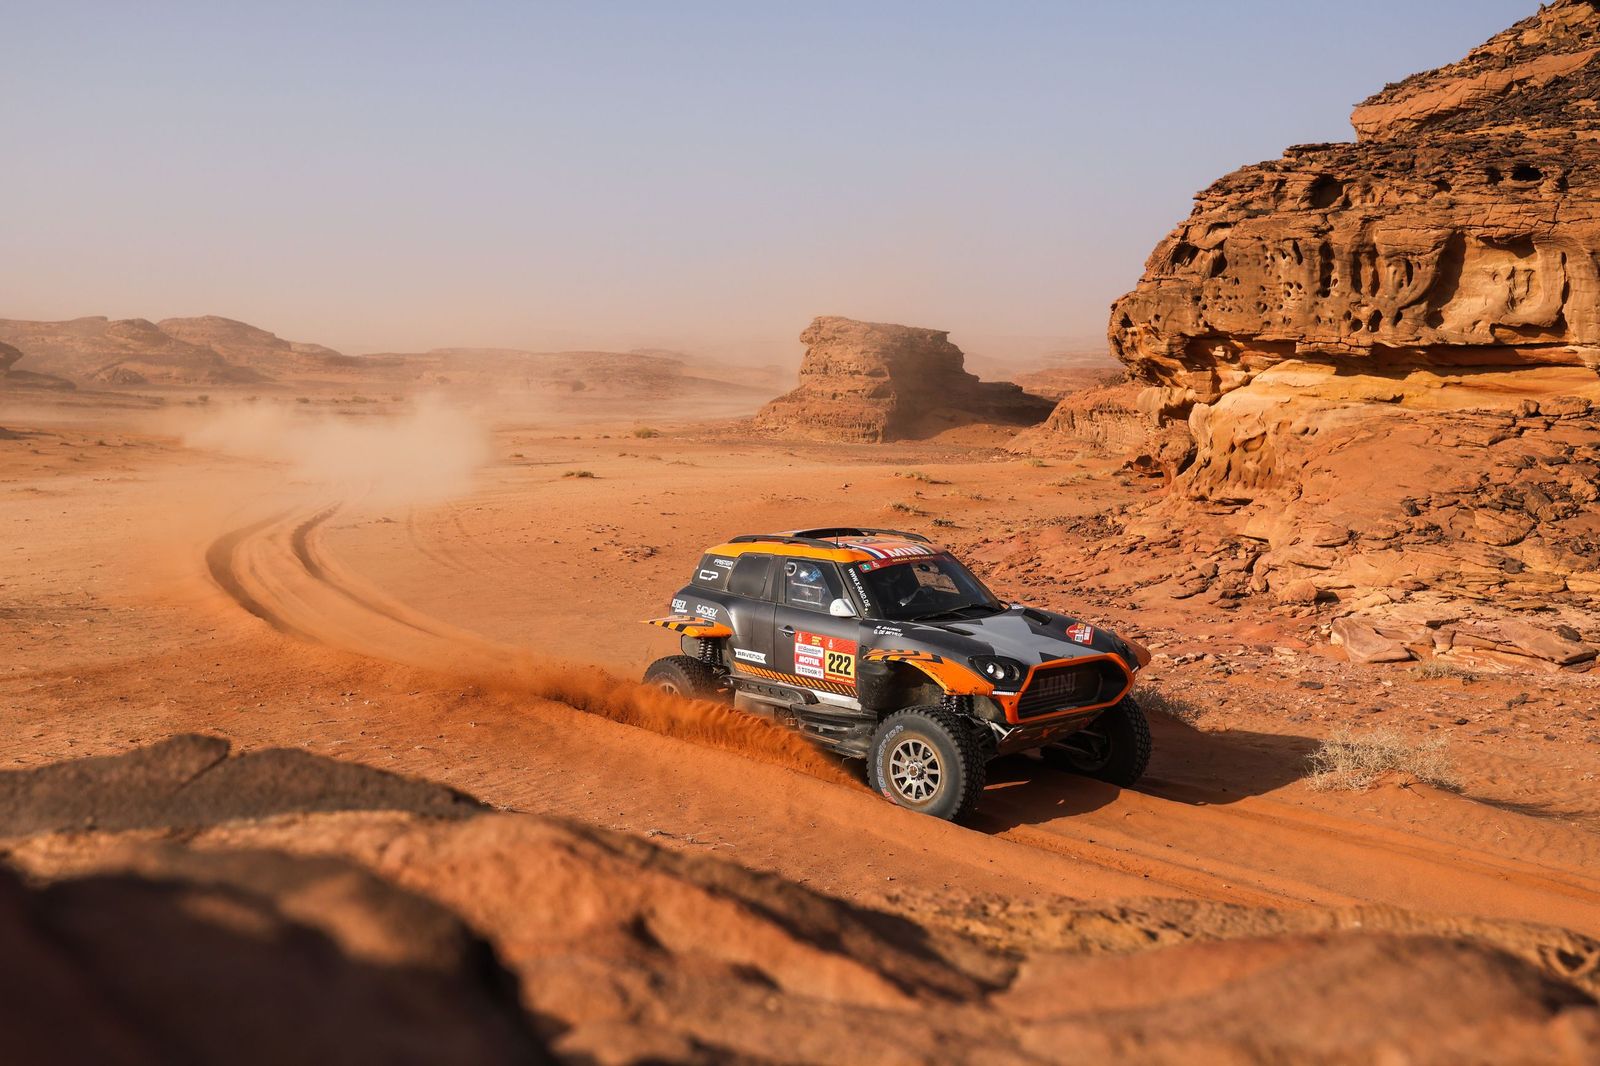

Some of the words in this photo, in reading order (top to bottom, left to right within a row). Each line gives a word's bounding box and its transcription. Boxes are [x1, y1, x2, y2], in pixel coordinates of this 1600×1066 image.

[884, 545, 930, 557] MINI
[700, 569, 719, 580] CP
[798, 655, 820, 666] MOTUL
[828, 653, 851, 676] 222
